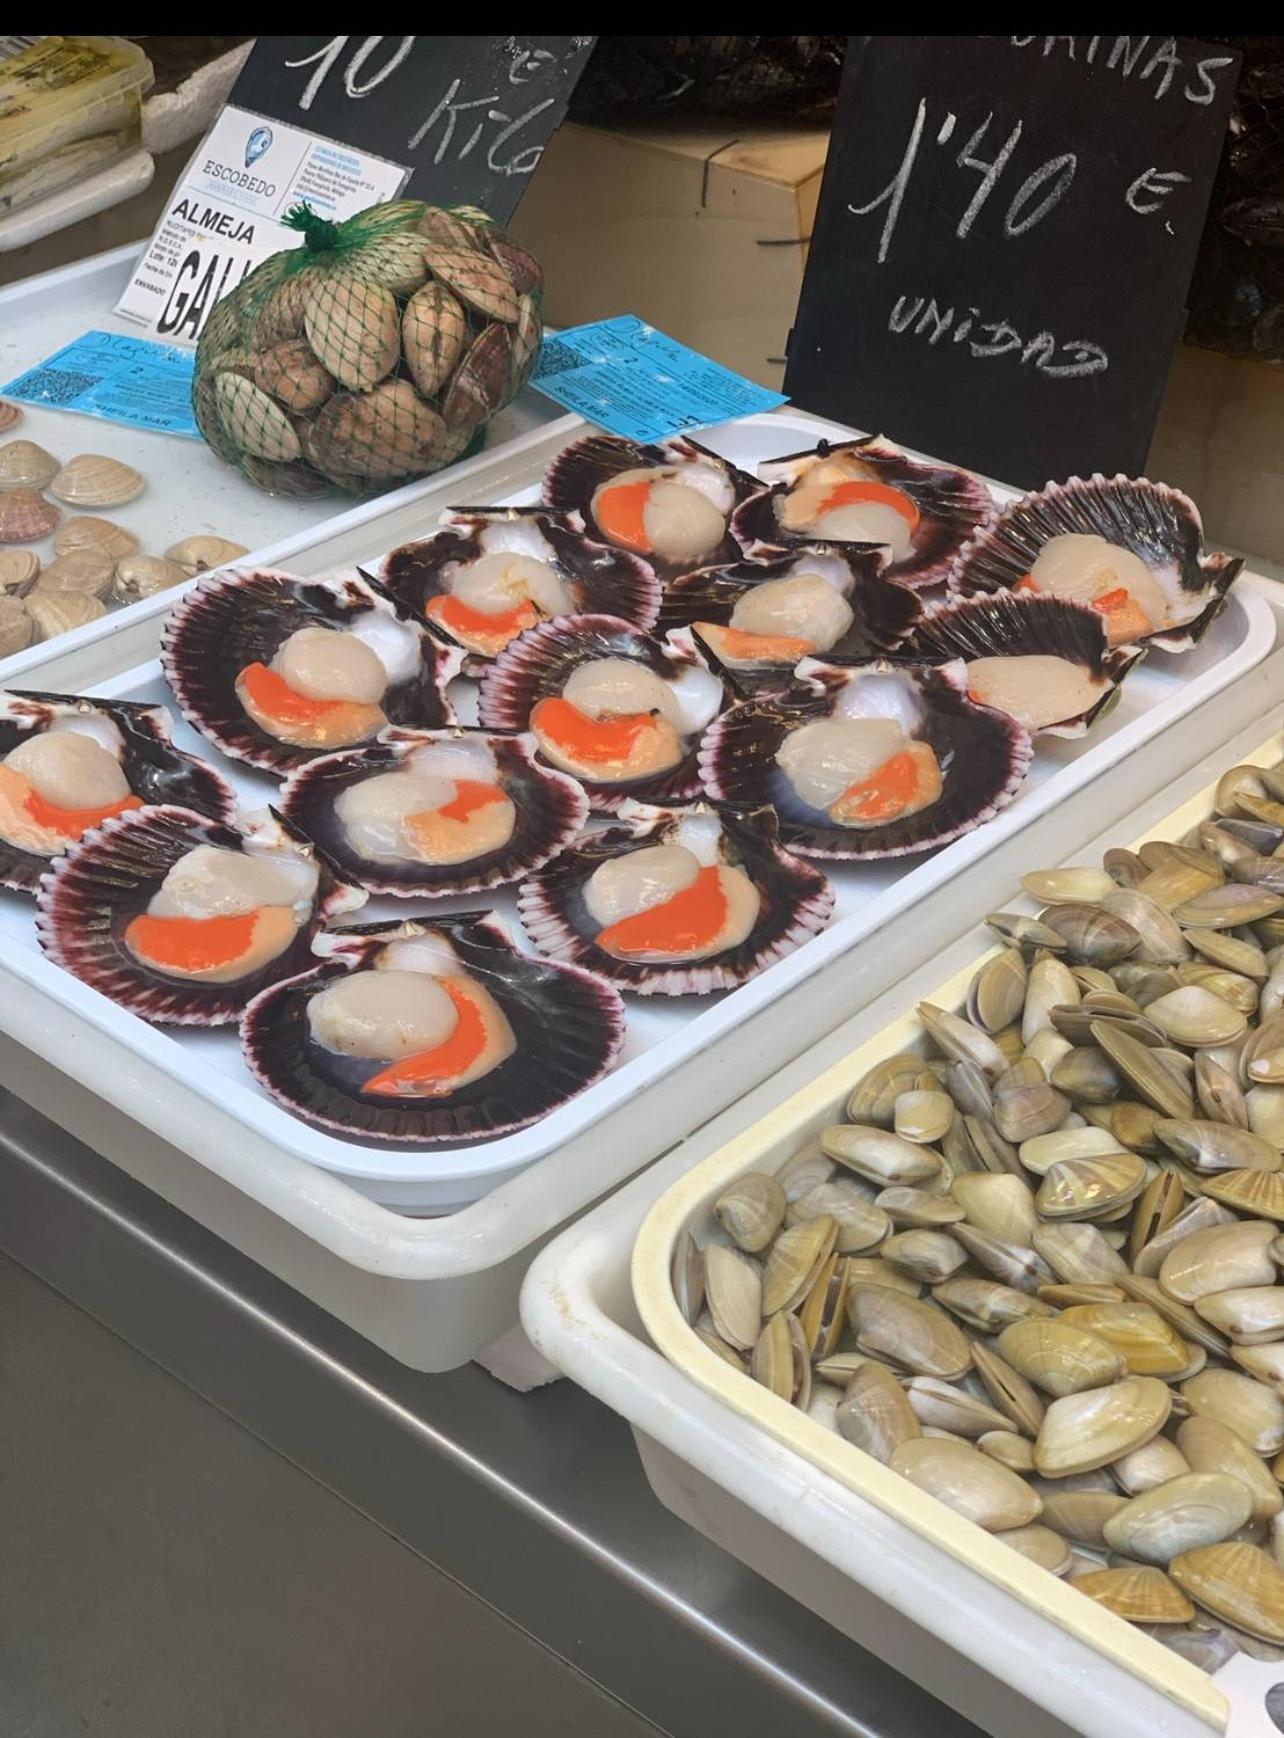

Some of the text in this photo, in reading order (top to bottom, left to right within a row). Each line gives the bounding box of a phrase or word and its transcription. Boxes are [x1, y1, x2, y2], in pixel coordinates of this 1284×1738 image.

[202, 160, 276, 197] ESCOBEDO
[172, 199, 255, 244] ALMEJA
[156, 249, 252, 340] GAL
